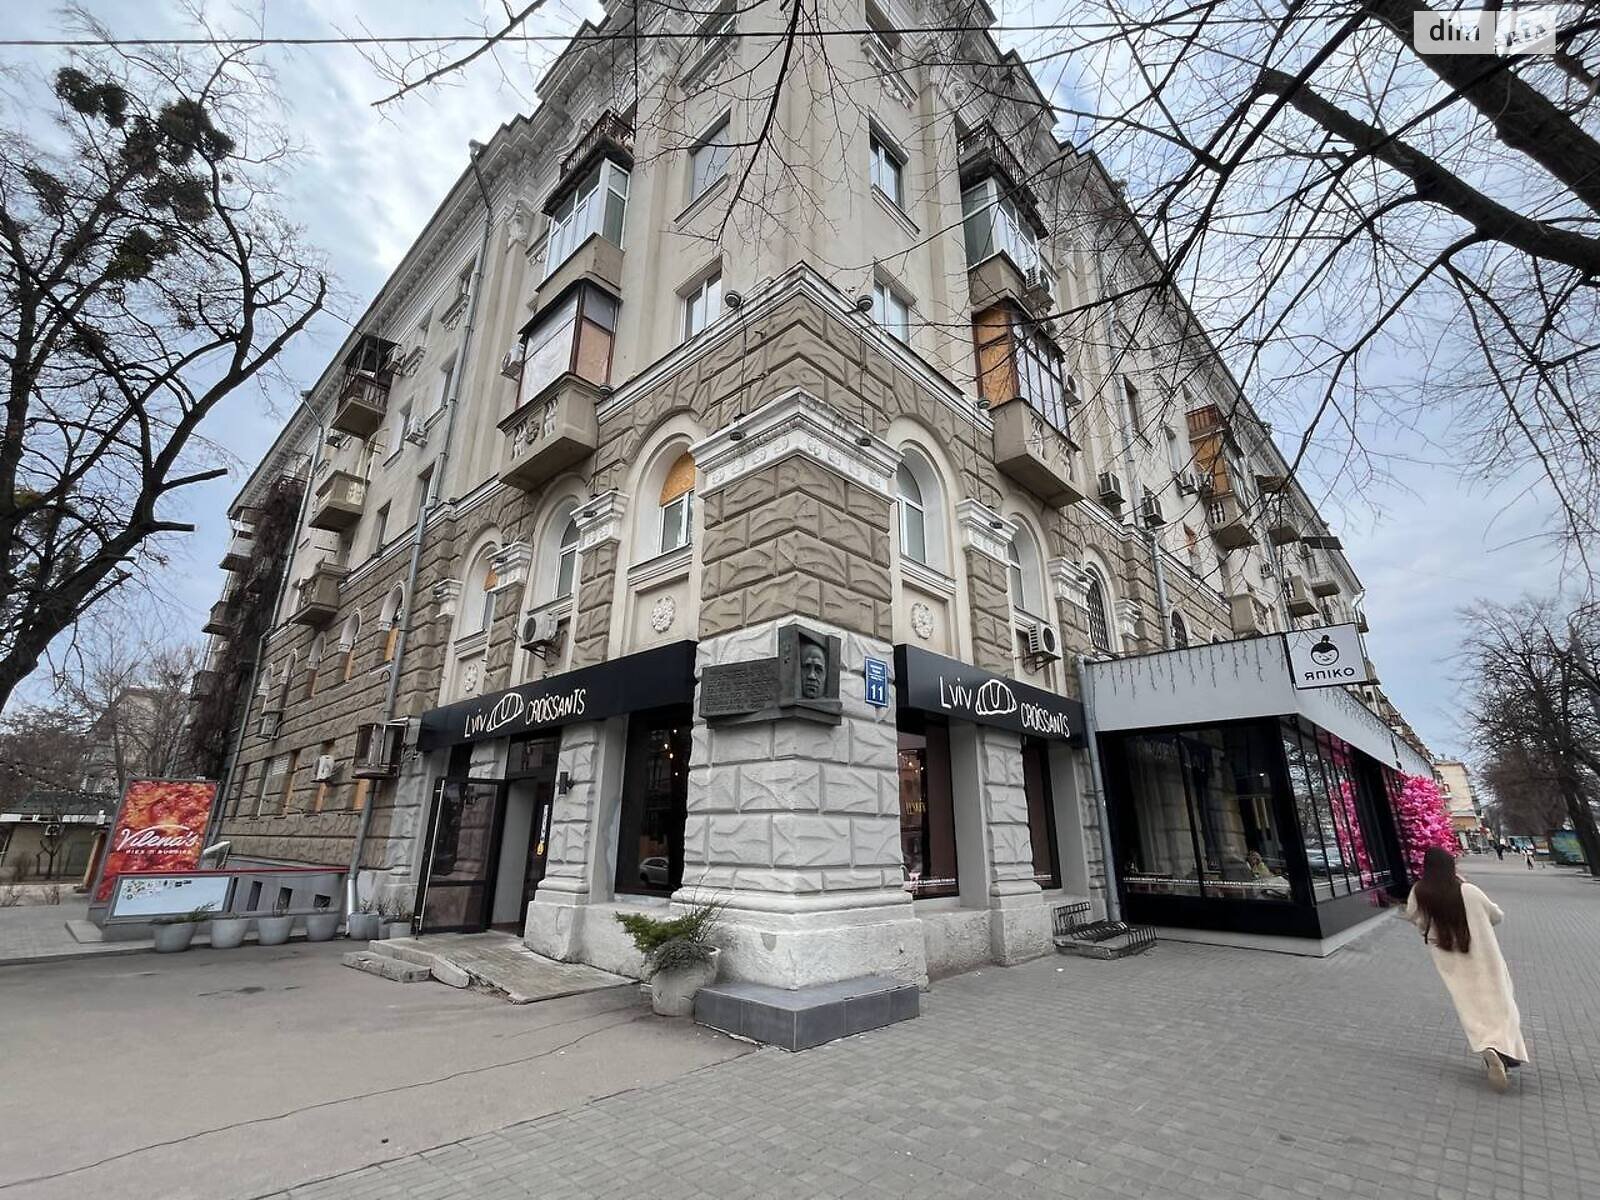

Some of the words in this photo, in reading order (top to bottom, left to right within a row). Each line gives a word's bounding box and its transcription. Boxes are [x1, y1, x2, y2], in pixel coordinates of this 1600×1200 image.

[464, 708, 488, 738] Lviv
[525, 688, 587, 725] CROISSANTS
[870, 684, 884, 701] 11
[939, 675, 972, 710] Lviv
[1020, 702, 1071, 738] CROISSANTS
